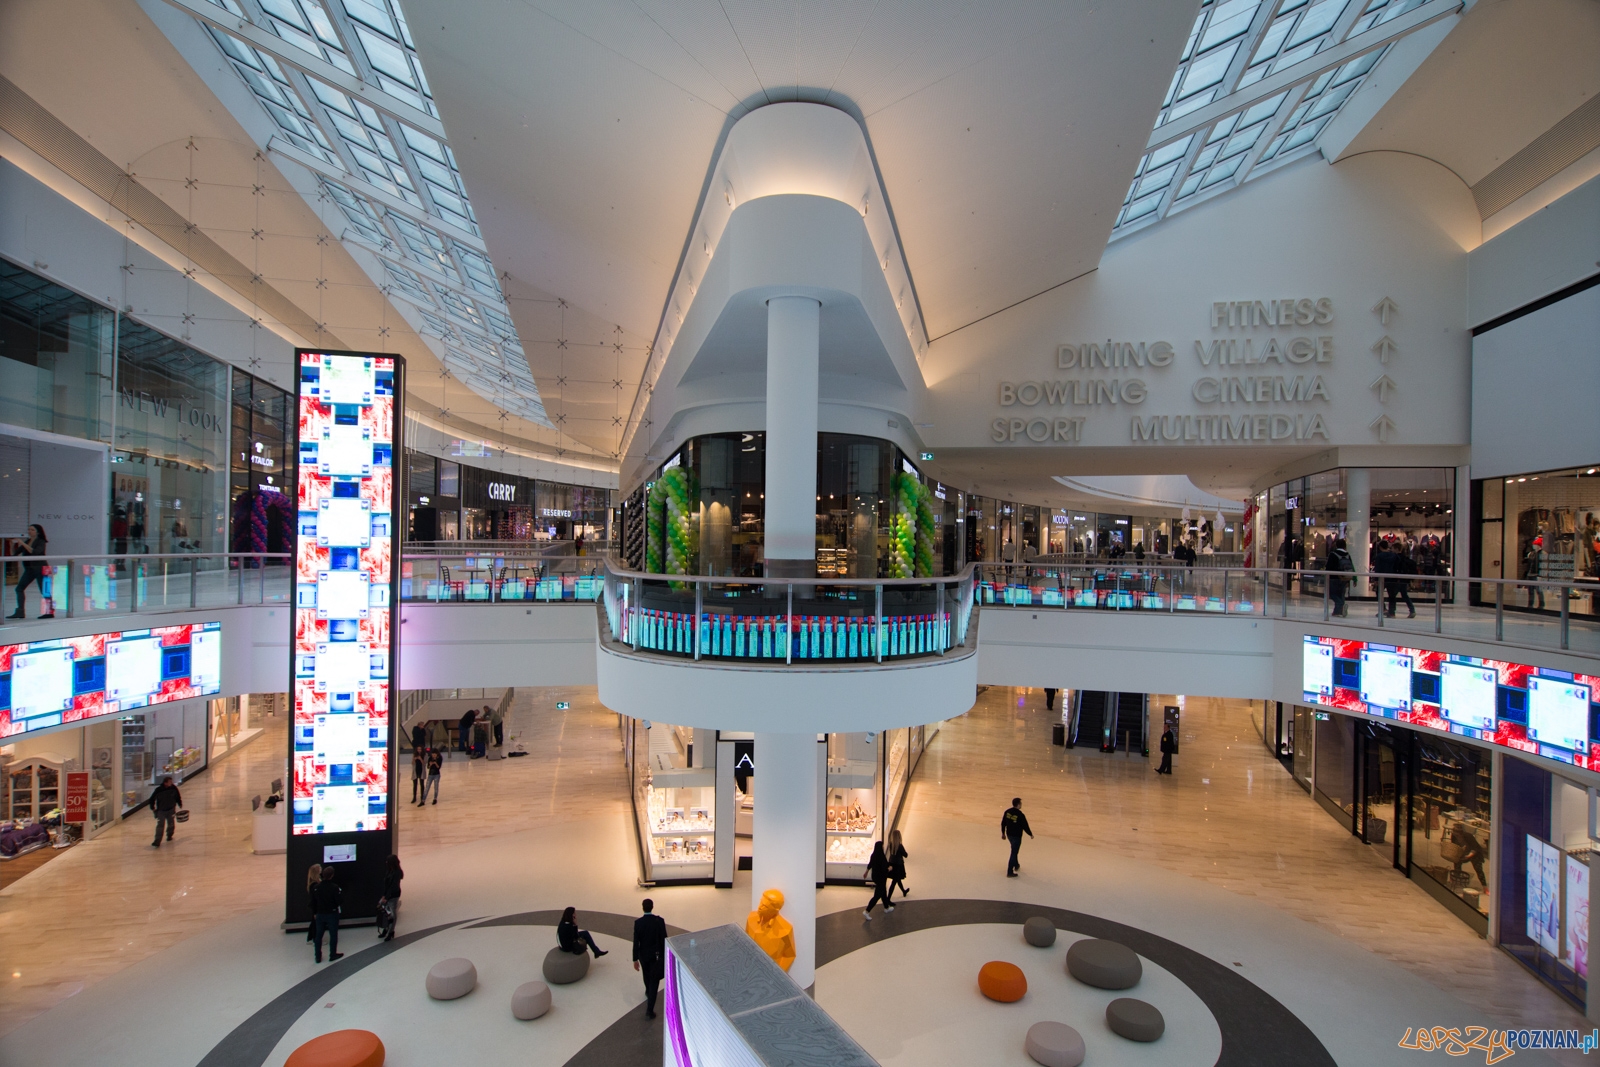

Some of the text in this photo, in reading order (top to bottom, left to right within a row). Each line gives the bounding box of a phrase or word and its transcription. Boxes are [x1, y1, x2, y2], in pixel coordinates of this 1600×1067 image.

[1211, 297, 1334, 328] FITNESS
[1057, 336, 1333, 369] DINING VILLAGE
[1000, 375, 1331, 406] BOWLING CINEMA
[121, 386, 222, 434] NEW LOOK
[991, 413, 1331, 443] SPORT MULTIMEDIA
[488, 482, 516, 502] CARRY
[543, 508, 572, 518] RESERVED
[67, 795, 87, 806] 50%
